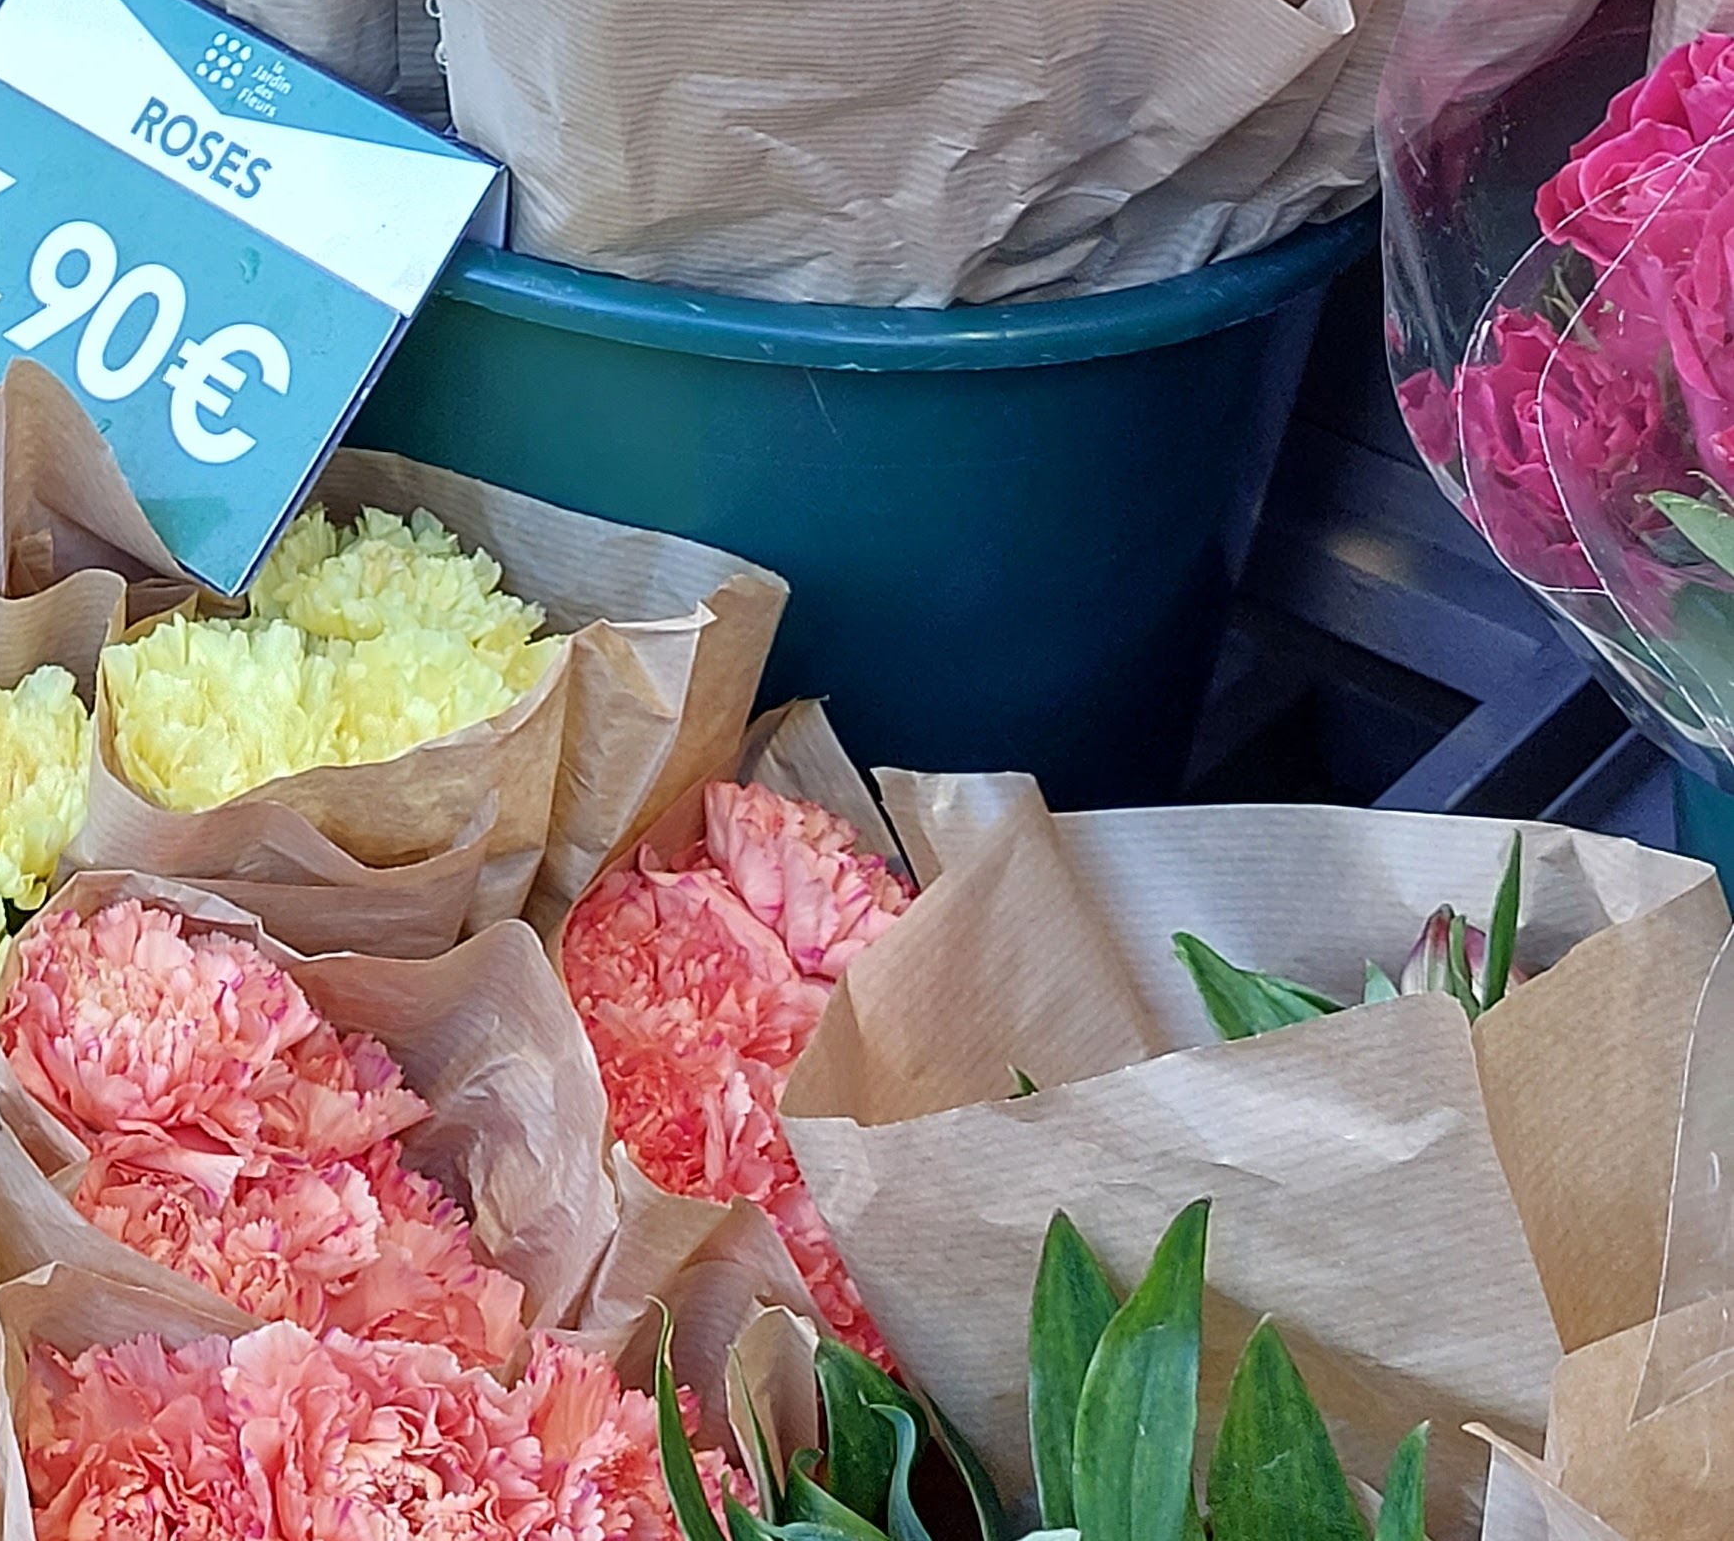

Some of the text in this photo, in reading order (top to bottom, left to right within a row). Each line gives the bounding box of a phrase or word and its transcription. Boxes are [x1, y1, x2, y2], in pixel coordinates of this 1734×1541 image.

[251, 64, 292, 94] Jardin
[271, 60, 285, 74] le
[236, 87, 277, 117] Fleurs
[254, 84, 275, 100] des
[129, 96, 273, 201] ROSES
